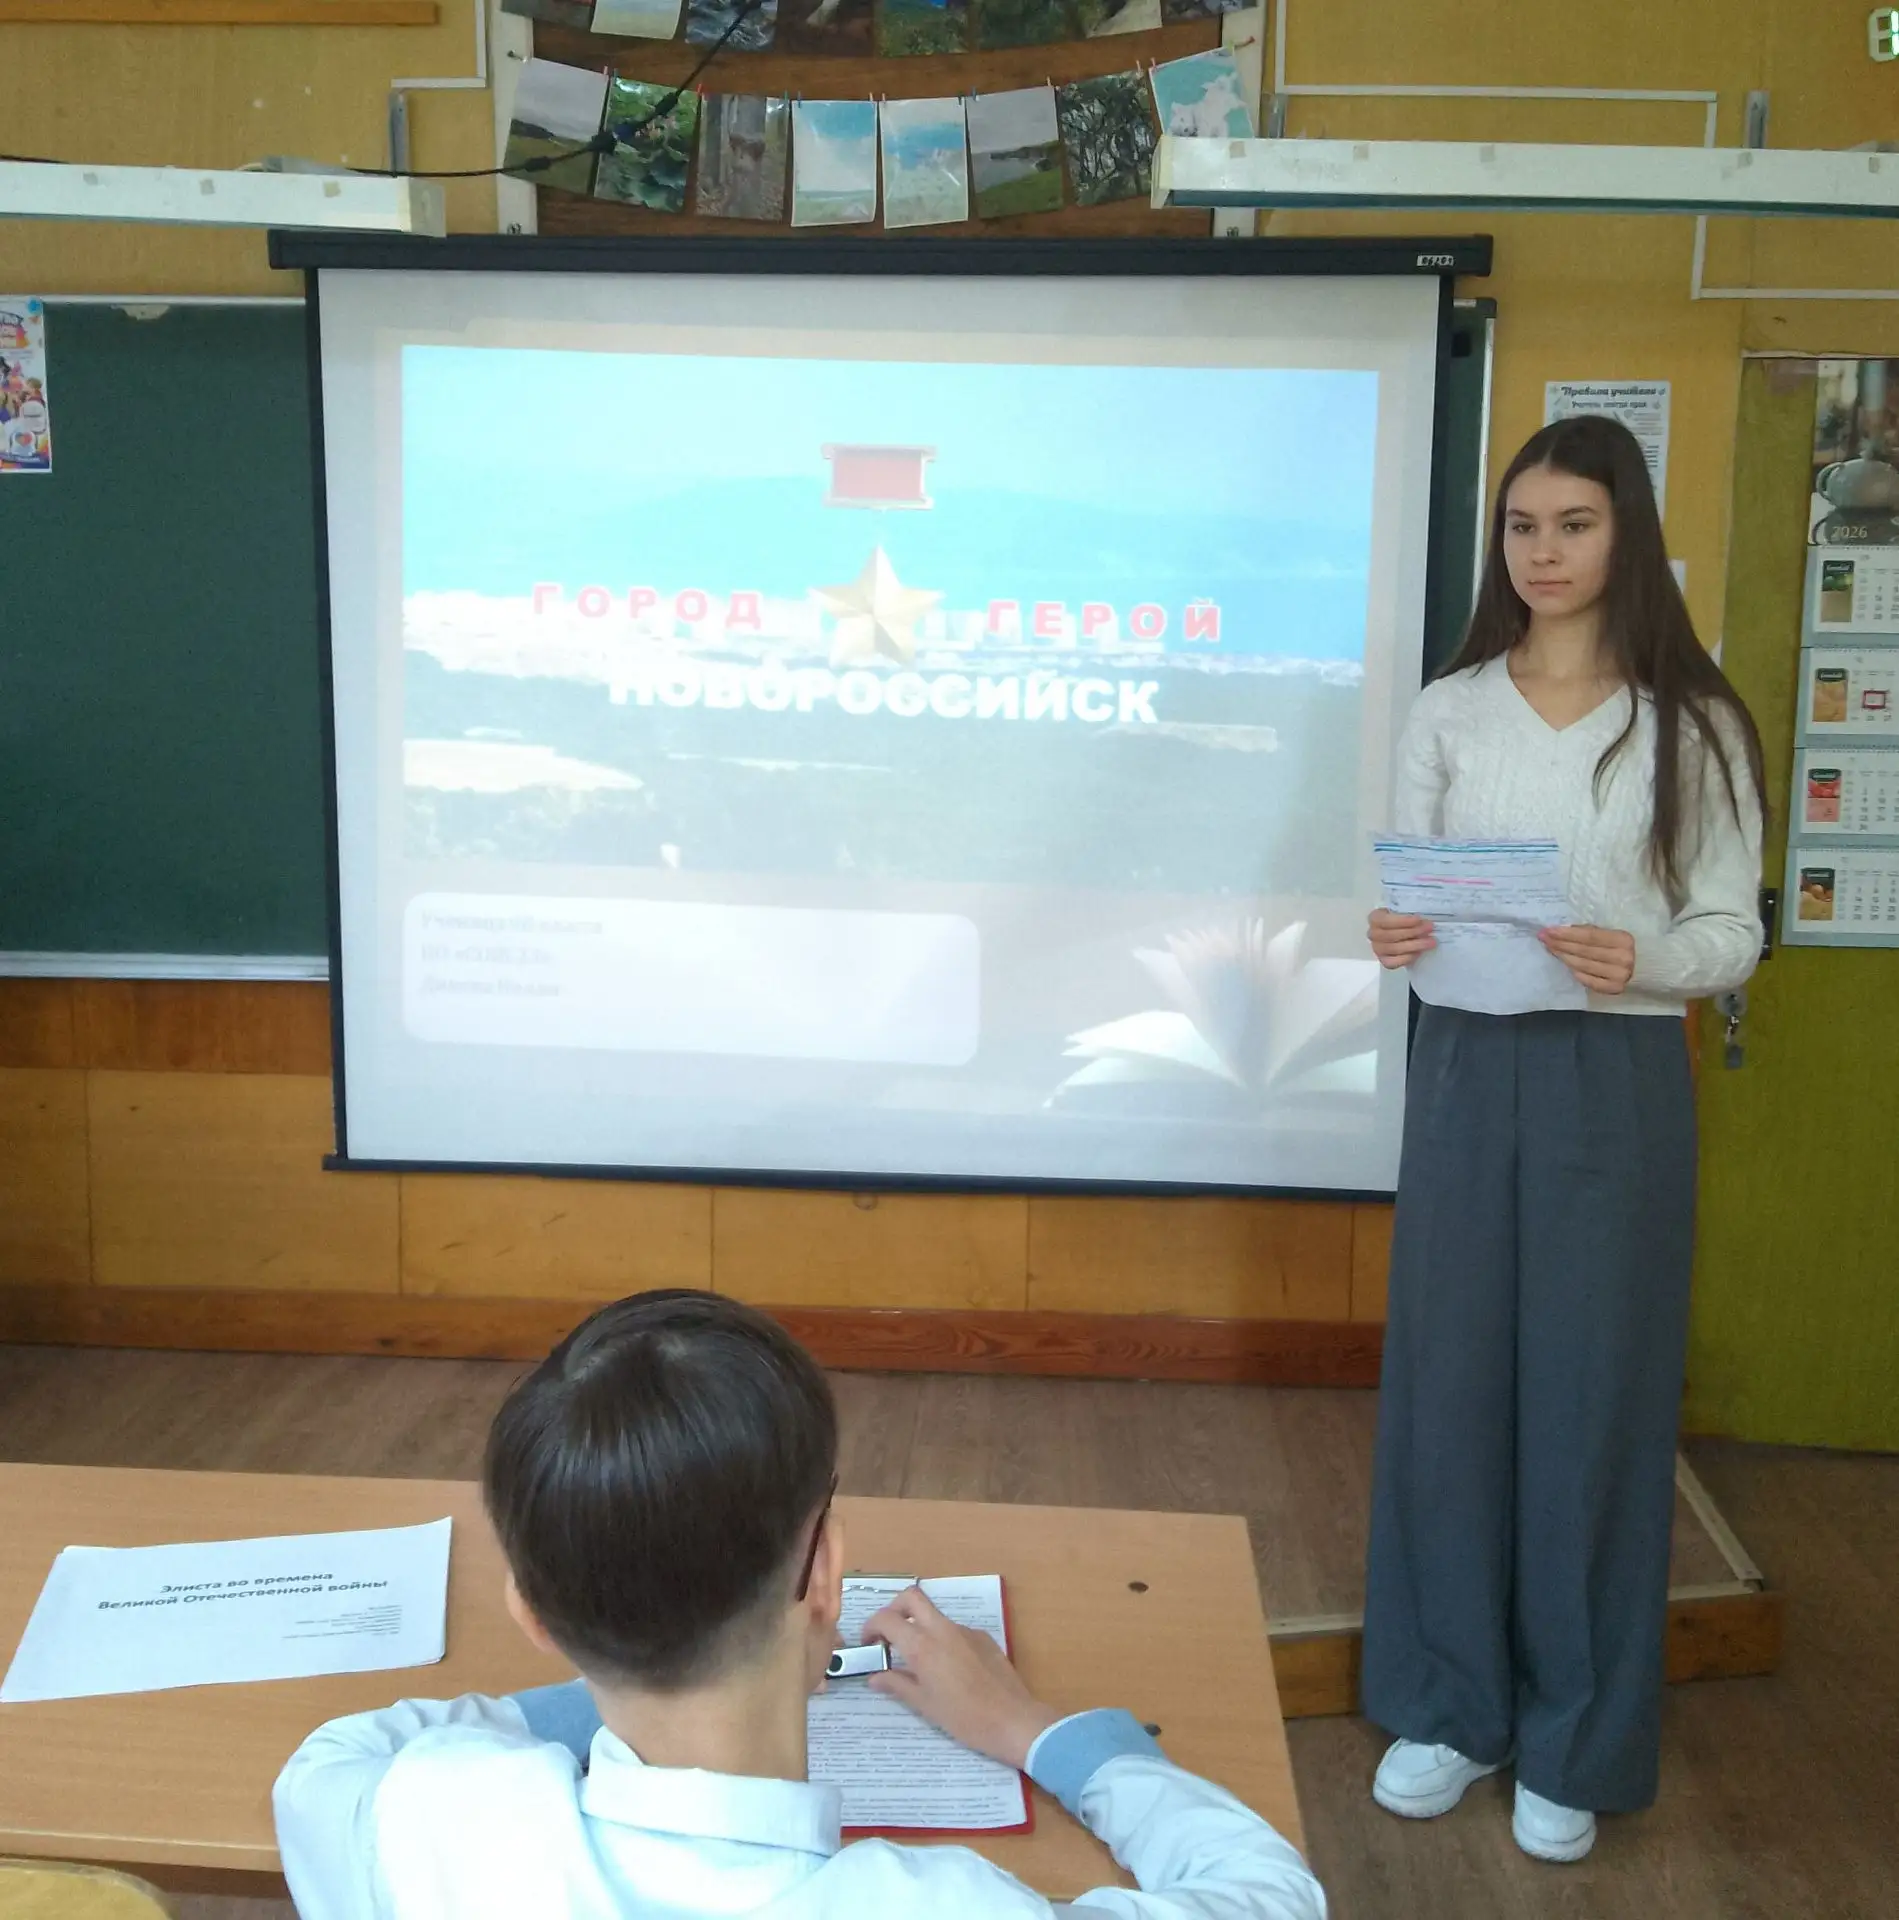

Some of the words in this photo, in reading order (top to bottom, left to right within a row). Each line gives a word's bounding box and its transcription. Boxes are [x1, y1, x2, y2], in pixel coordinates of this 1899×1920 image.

[1831, 525, 1869, 539] 2026
[532, 583, 763, 631] ГОРОД
[985, 597, 1221, 642] ГЕРОЙ
[607, 662, 1161, 724] НОВОРОССИЙСК
[97, 1596, 179, 1610] Великой
[183, 1584, 324, 1603] Отечественной
[327, 1580, 388, 1592] войны
[159, 1582, 223, 1594] Элиста
[226, 1579, 249, 1588] во
[254, 1572, 334, 1586] времена
